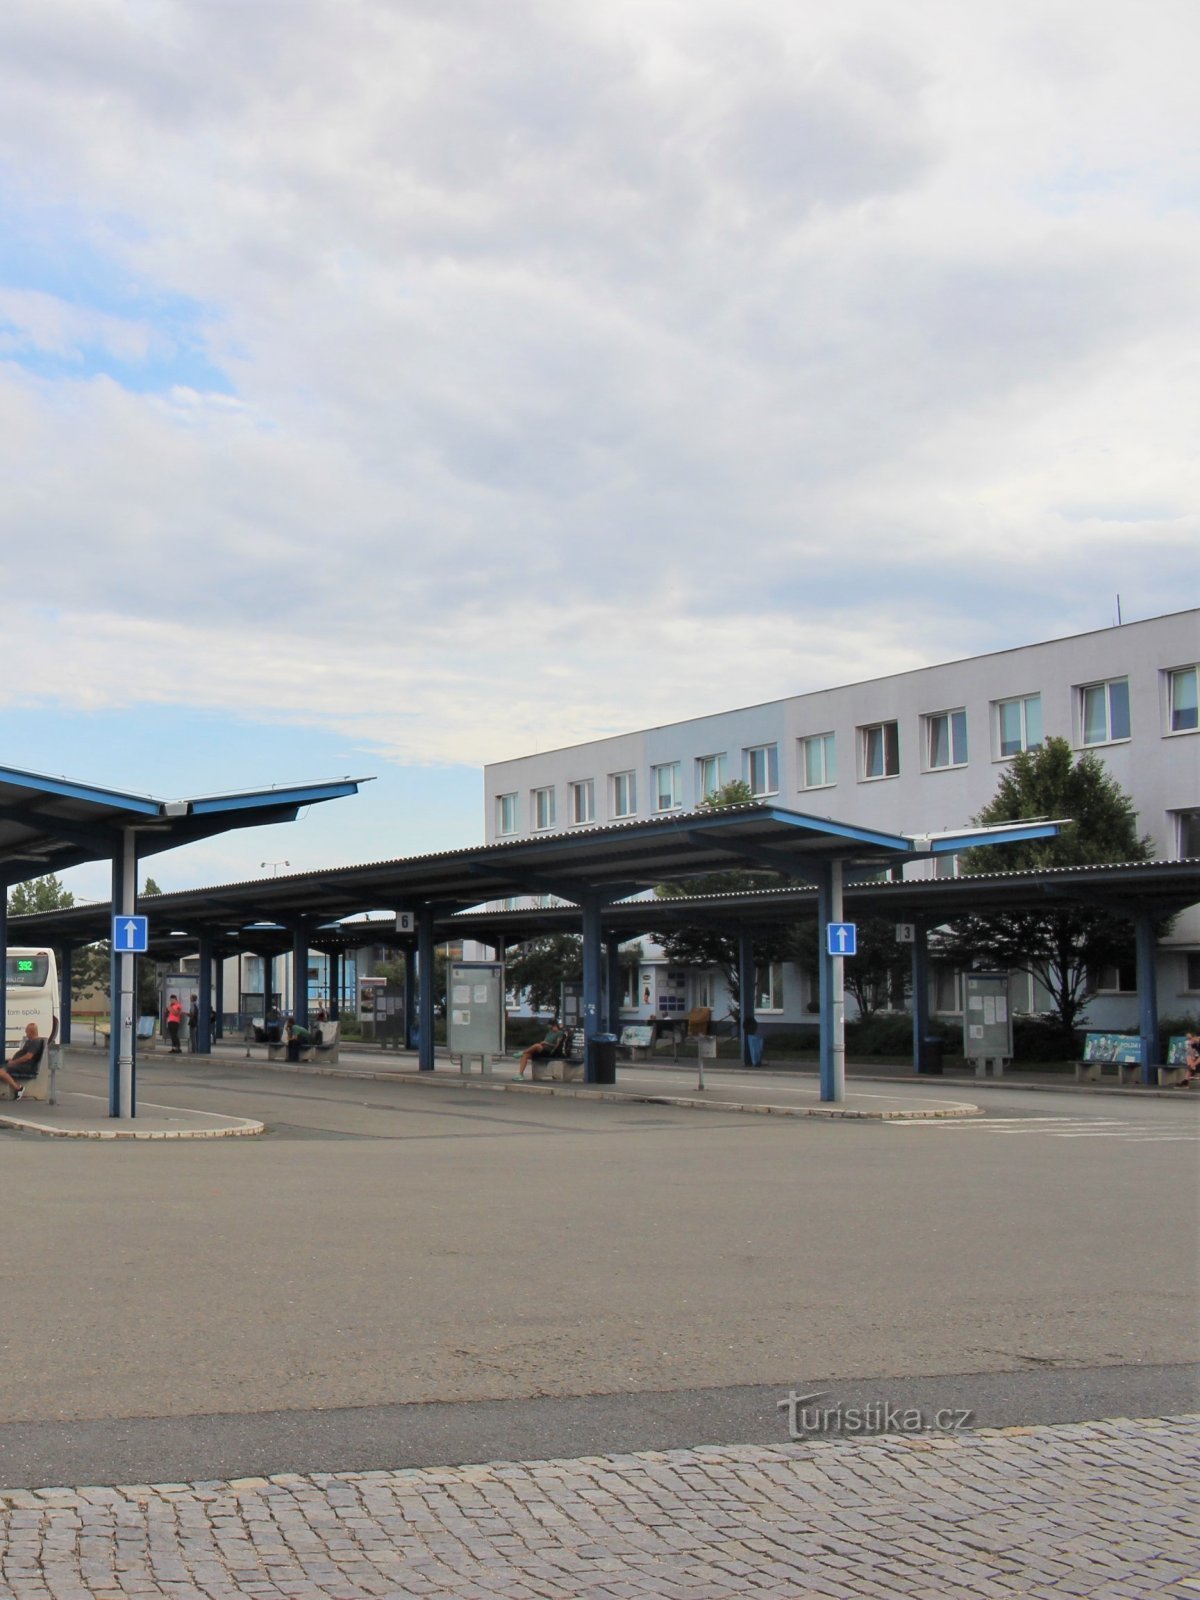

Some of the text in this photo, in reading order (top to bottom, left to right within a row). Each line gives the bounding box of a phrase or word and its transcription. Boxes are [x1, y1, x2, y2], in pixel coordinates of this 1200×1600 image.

[401, 915, 409, 929] 6
[904, 926, 911, 939] 3
[21, 1008, 41, 1017] spolu
